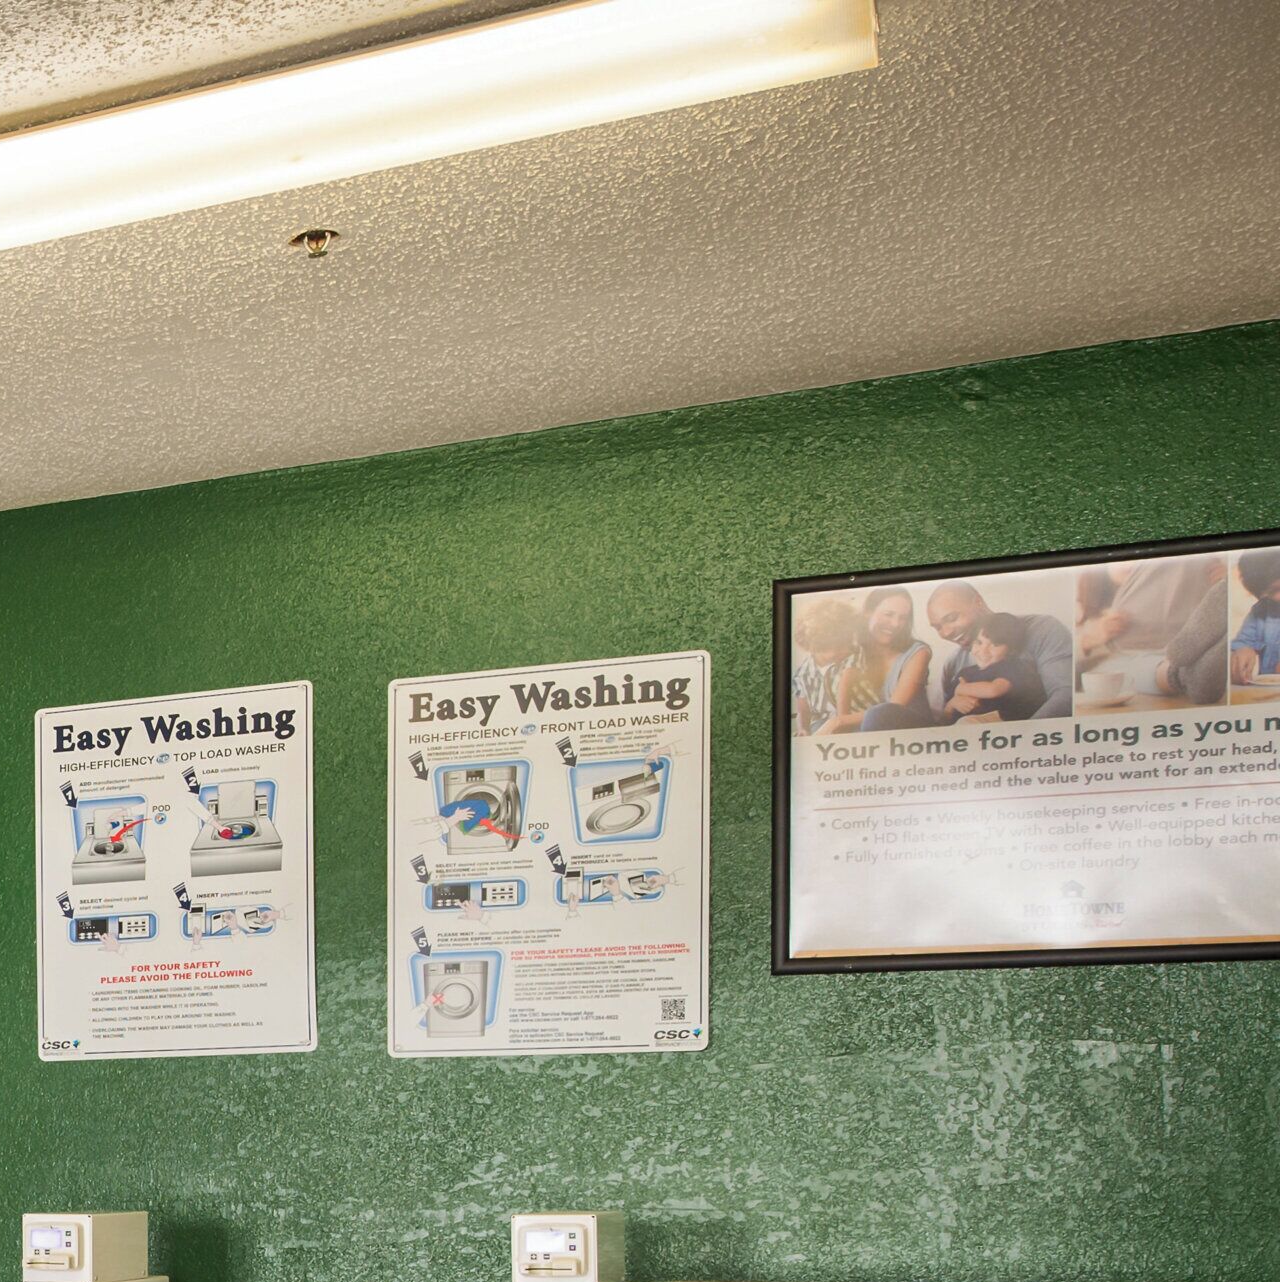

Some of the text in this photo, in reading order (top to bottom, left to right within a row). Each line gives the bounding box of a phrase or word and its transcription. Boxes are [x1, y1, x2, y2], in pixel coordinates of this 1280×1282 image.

[408, 674, 691, 727] Easy Washing
[52, 707, 296, 755] Easy Washing
[408, 711, 689, 745] HIGH-EFFICIENCY FRONT LOAD WASHER
[816, 742, 880, 761] Your
[890, 737, 968, 757] home
[979, 730, 1022, 750] for
[1032, 731, 1063, 746] as
[1074, 724, 1139, 746] long
[1151, 723, 1184, 738] as
[1194, 718, 1252, 742] you
[59, 742, 286, 773] HIGH-EFFICIENCY TOP LOAD WASHER
[815, 741, 1277, 783] You'll find a clean and comfortable place to rest your head,
[823, 784, 893, 800] amenities
[898, 782, 926, 797] you
[931, 778, 969, 793] need
[974, 775, 1001, 789] and
[1007, 772, 1032, 787] the
[1037, 770, 1079, 785] value
[1084, 771, 1113, 785] you
[1119, 767, 1159, 780] want
[1165, 764, 1189, 777] for
[1194, 764, 1213, 776] an
[152, 803, 171, 812] POD
[831, 817, 879, 832] Comfy
[884, 813, 920, 828] beds
[997, 803, 1107, 821] housekeeping
[1111, 799, 1175, 814] services
[1195, 796, 1231, 810] Free
[528, 822, 550, 831] POD
[874, 832, 897, 845] HD
[1048, 820, 1090, 836] cable
[1108, 814, 1226, 833] Well-equipped
[845, 850, 880, 866] Fully
[1063, 837, 1112, 853] coffee
[1118, 836, 1131, 849] in
[1137, 835, 1163, 848] the
[1168, 832, 1214, 849] lobby
[1220, 830, 1258, 845] each
[1081, 854, 1141, 872] laundry
[100, 968, 253, 984] PLEASE AVOID THE FOLLOWING
[131, 960, 221, 973] FOR YOUR SAFETY
[42, 1040, 71, 1050] CSC
[654, 1029, 690, 1039] CSC
